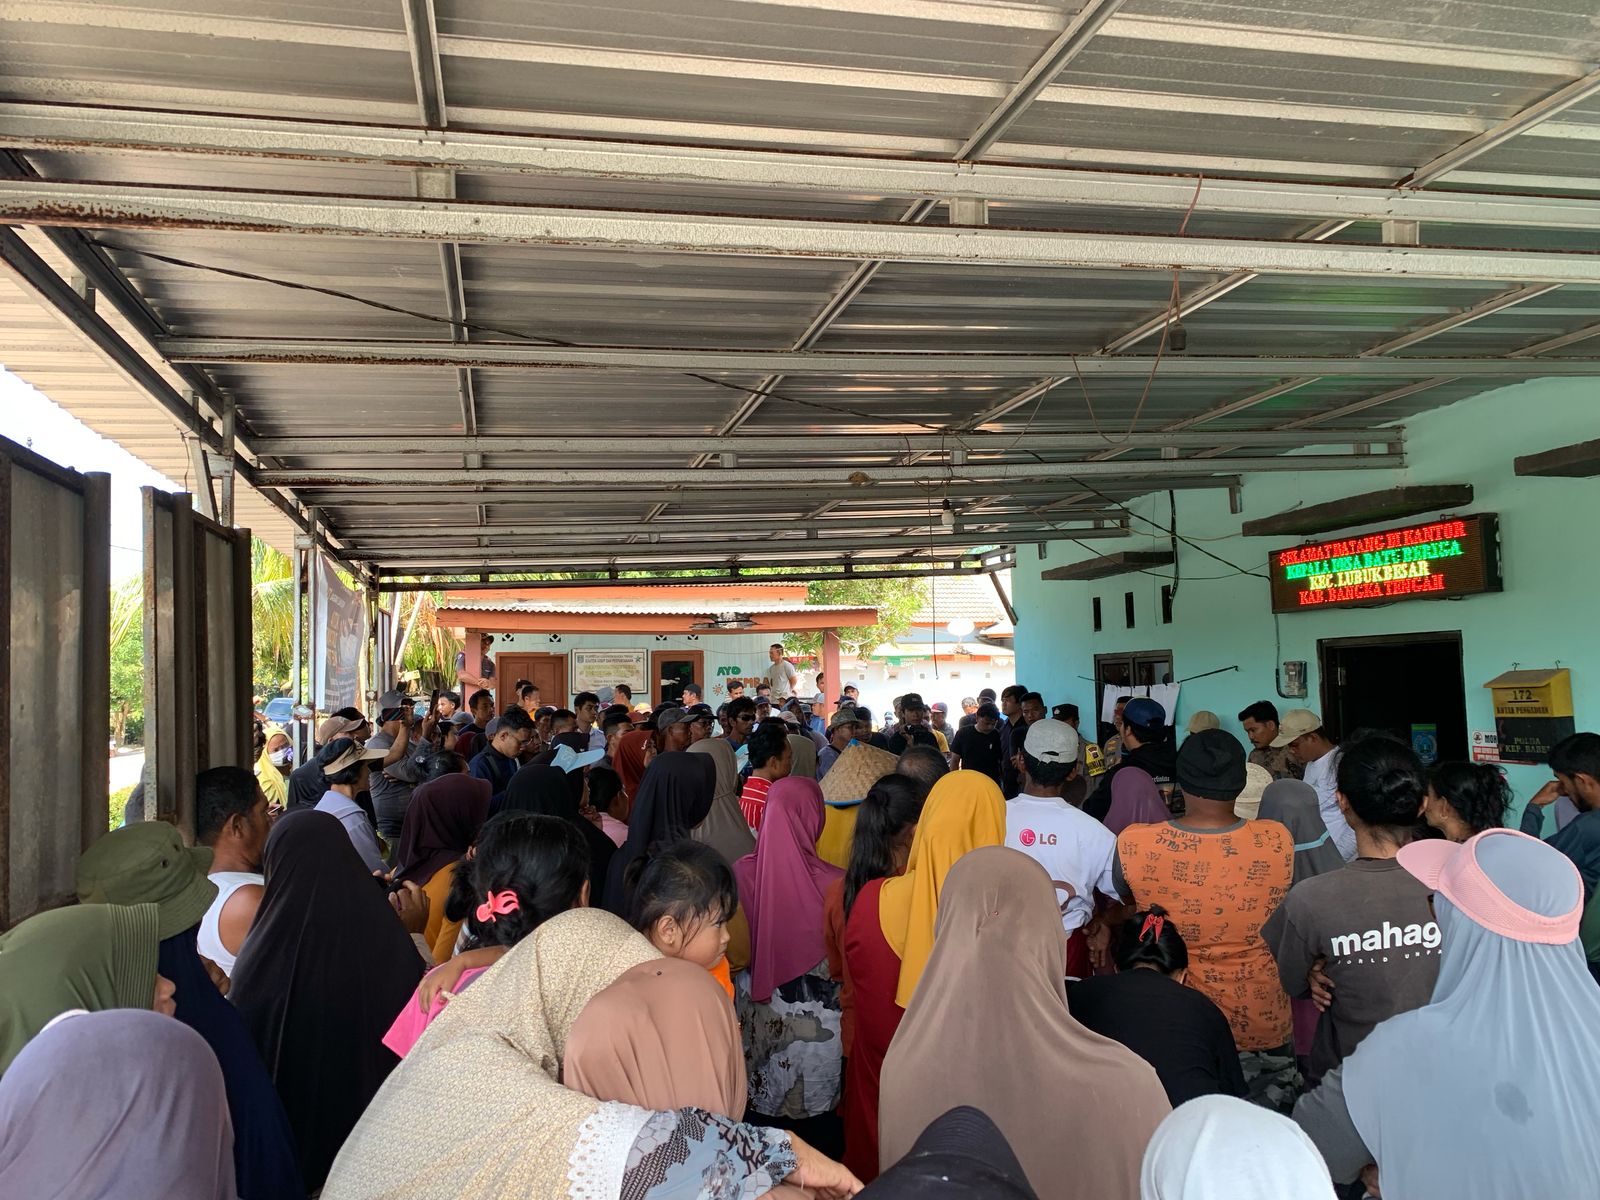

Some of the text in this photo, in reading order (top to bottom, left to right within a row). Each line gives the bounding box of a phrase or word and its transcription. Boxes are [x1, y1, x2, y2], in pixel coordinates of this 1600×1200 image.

[1403, 521, 1467, 545] KANTOR
[1338, 565, 1384, 588] LUBUK
[1384, 559, 1431, 581] BESAR
[717, 665, 742, 676] AYO
[1512, 690, 1533, 700] 172
[1514, 737, 1541, 745] POLDA
[1039, 833, 1057, 846] LG
